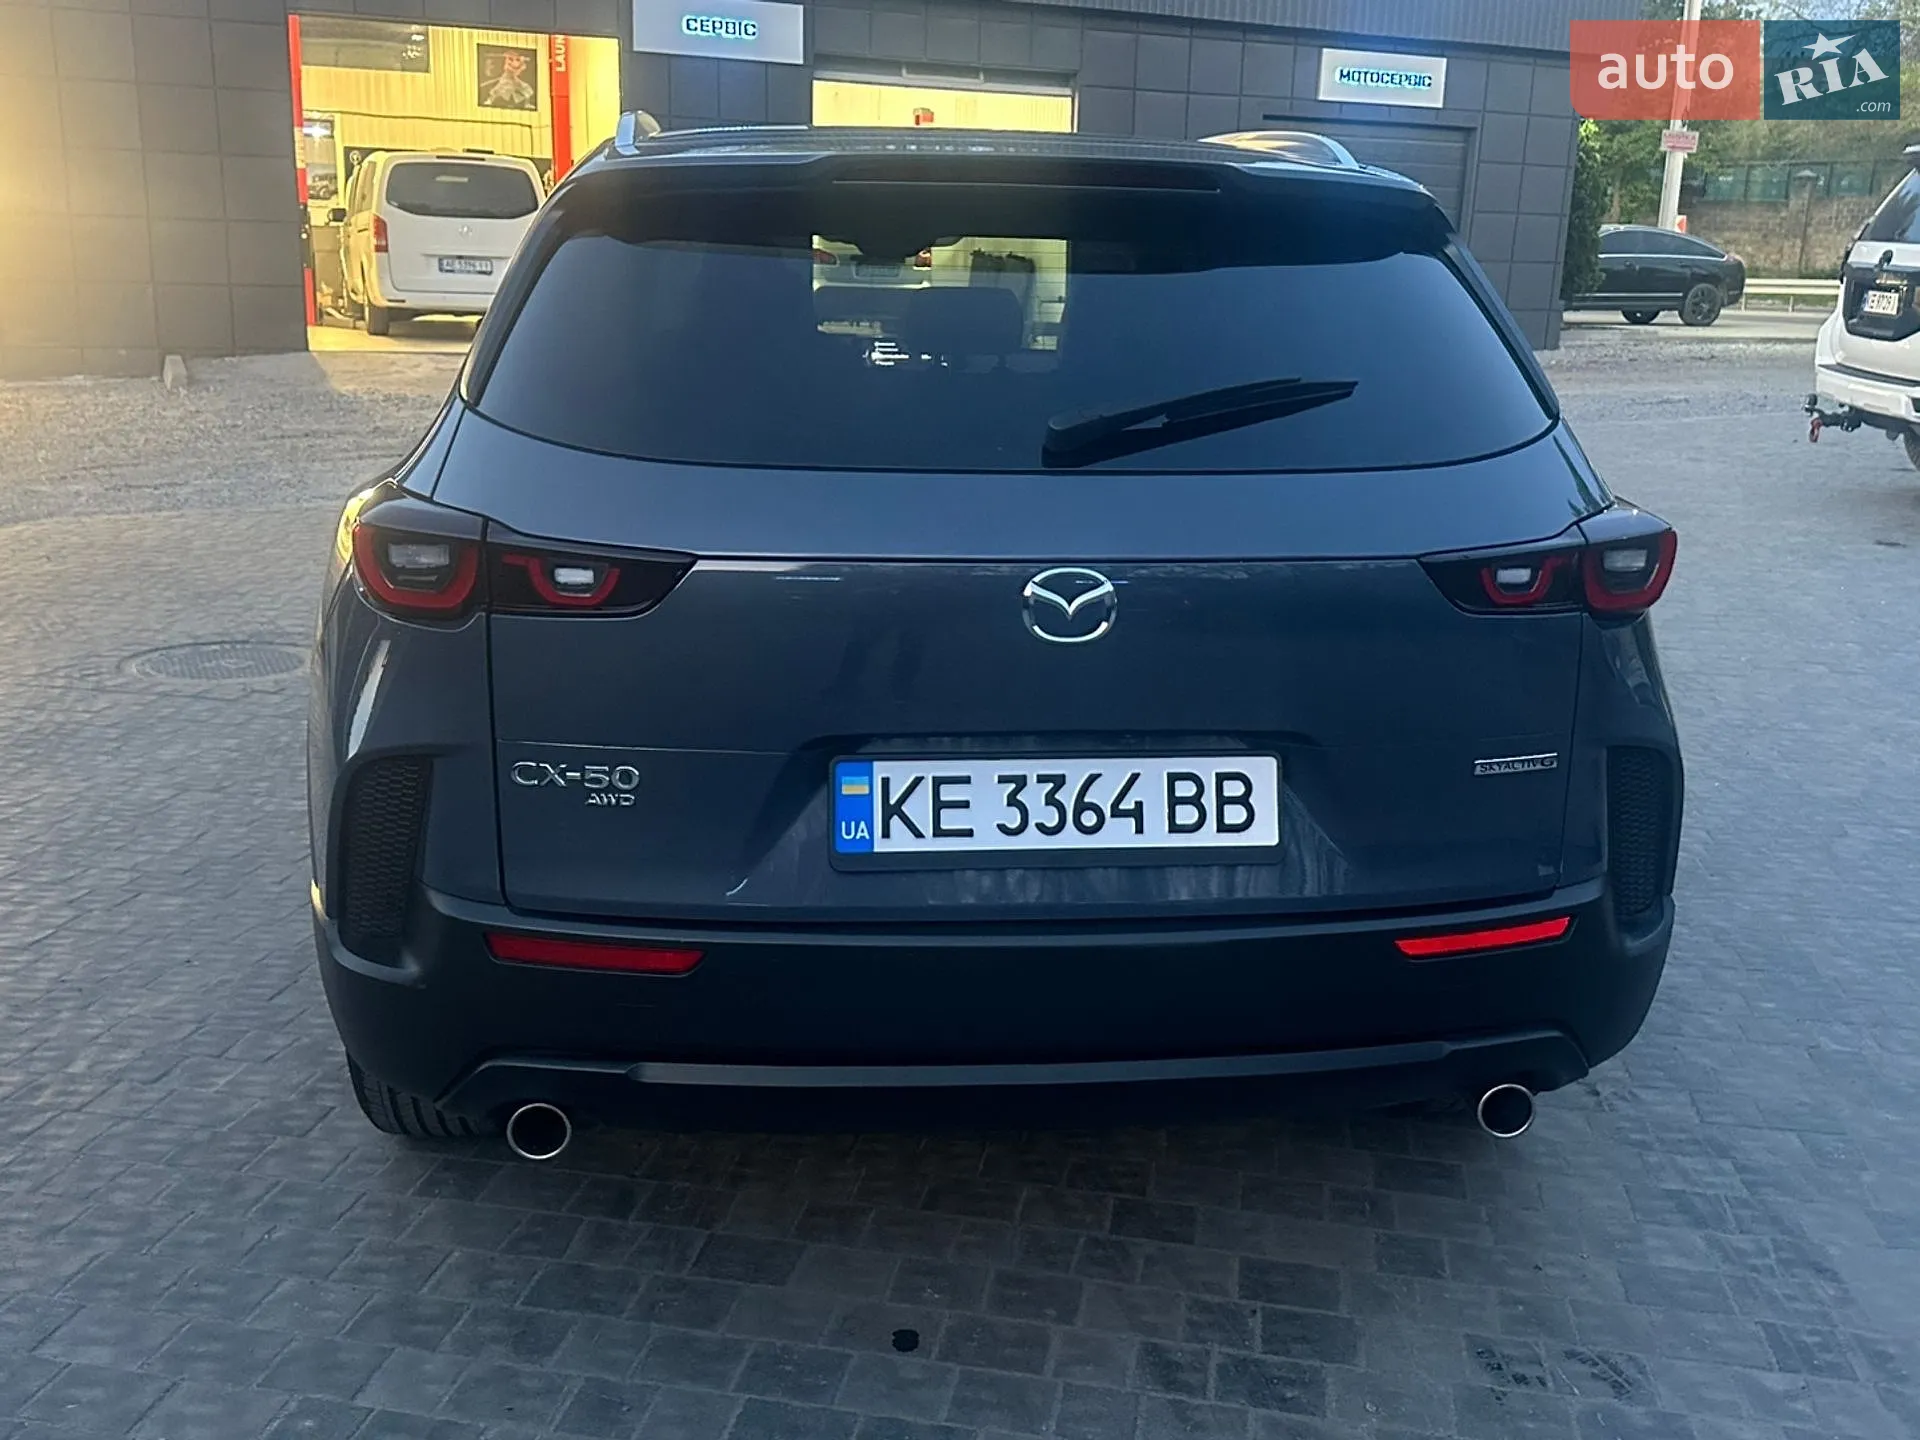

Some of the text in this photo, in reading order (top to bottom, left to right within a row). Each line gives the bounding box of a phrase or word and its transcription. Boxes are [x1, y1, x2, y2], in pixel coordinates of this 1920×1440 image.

[685, 17, 757, 37] СЕРВІС
[1339, 68, 1433, 88] МОТОСЕРВІС
[511, 760, 640, 790] CX-50
[584, 792, 635, 806] AWD
[880, 771, 1256, 839] KE 3364 BB
[841, 820, 870, 840] UA
